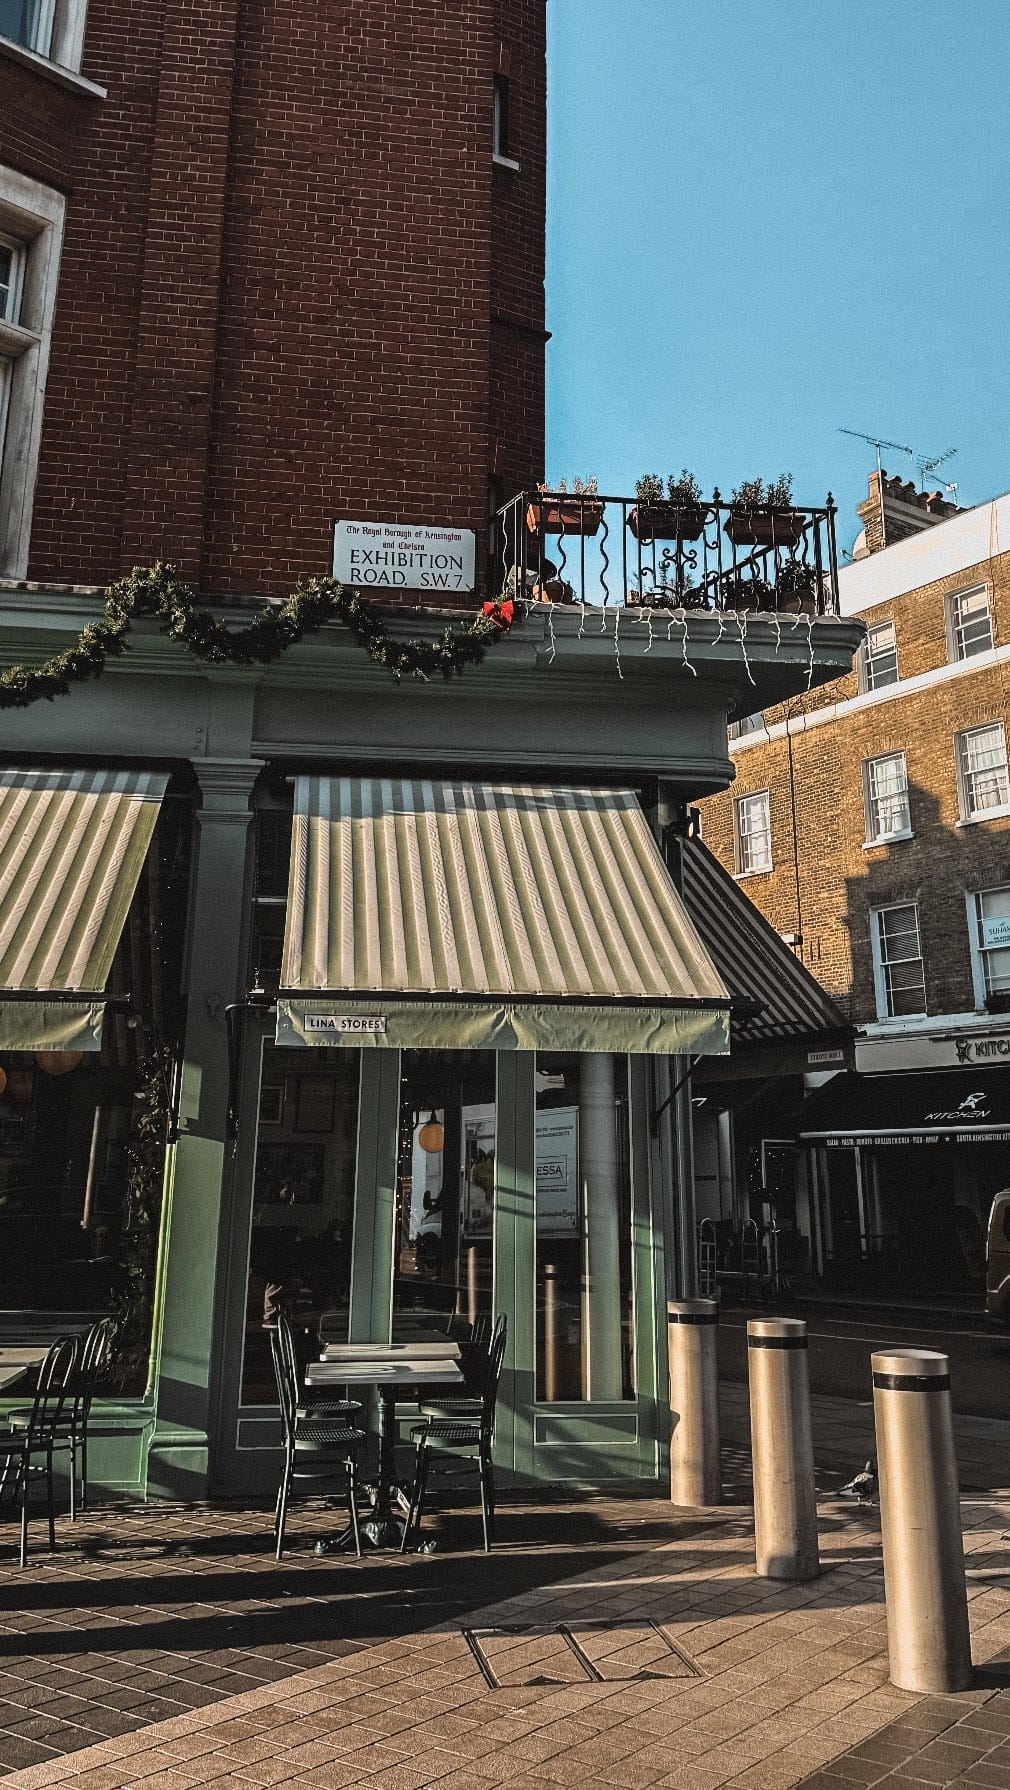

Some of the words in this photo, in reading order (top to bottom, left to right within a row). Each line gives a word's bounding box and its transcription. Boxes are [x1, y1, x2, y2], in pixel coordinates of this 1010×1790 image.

[346, 525, 360, 534] The
[362, 526, 382, 538] Royal
[384, 528, 412, 540] Borough
[415, 530, 423, 538] of
[425, 531, 462, 543] Kensington
[382, 541, 395, 549] and
[398, 542, 425, 551] Chelsea
[350, 549, 463, 570] EXHIBITION
[350, 567, 408, 586] ROAD.
[310, 1019, 336, 1028] LINA
[341, 1019, 380, 1029] STORES
[924, 1110, 991, 1119] KITCHEN
